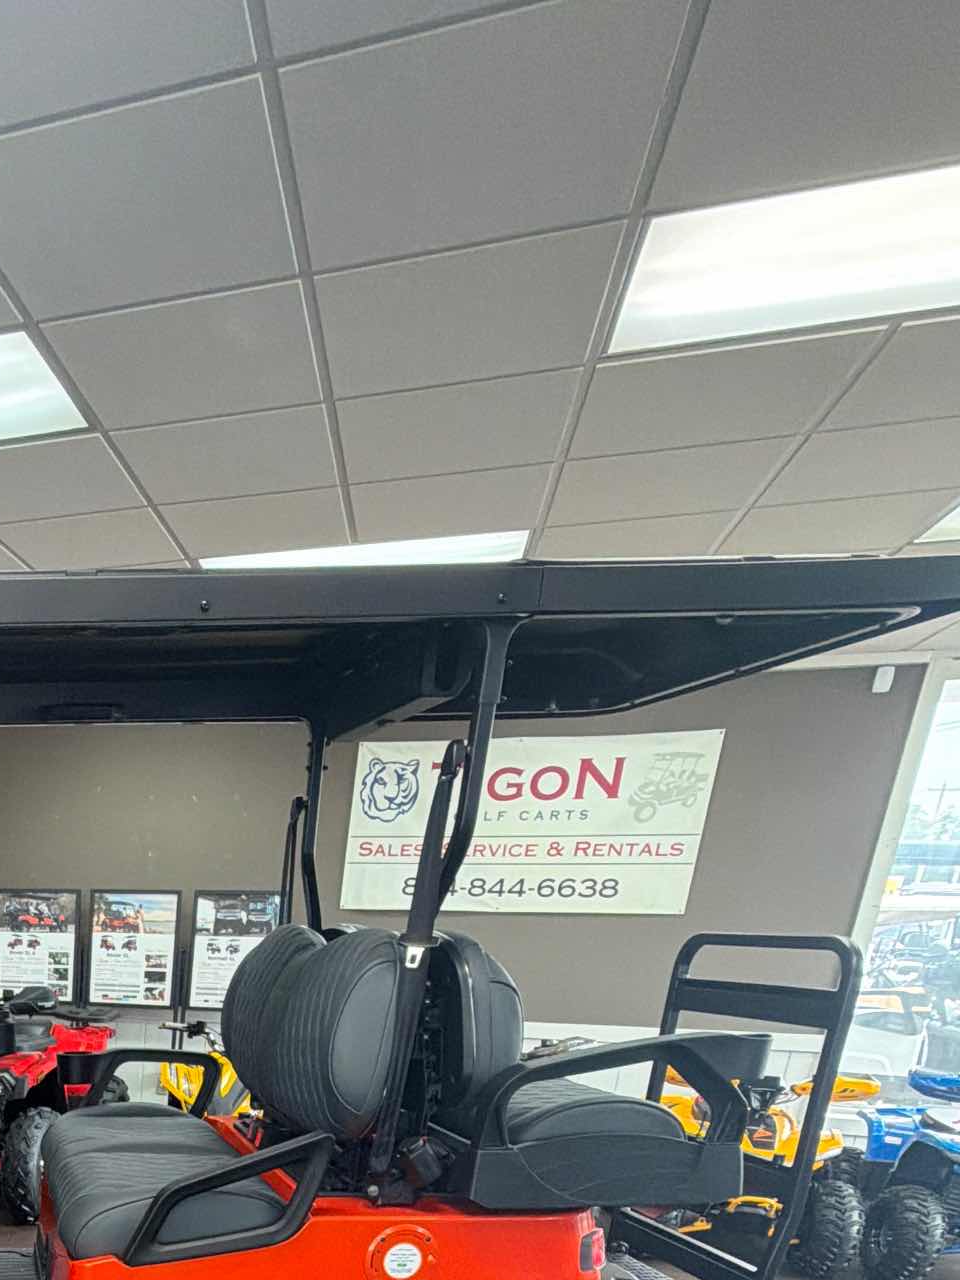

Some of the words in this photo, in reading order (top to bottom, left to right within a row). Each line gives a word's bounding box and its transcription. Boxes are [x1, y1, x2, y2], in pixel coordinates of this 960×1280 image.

[520, 809, 589, 821] CARTS
[441, 843, 538, 857] RVICE
[546, 841, 564, 857] &
[573, 841, 685, 857] RENTALS
[401, 876, 619, 898] 84-844-6638
